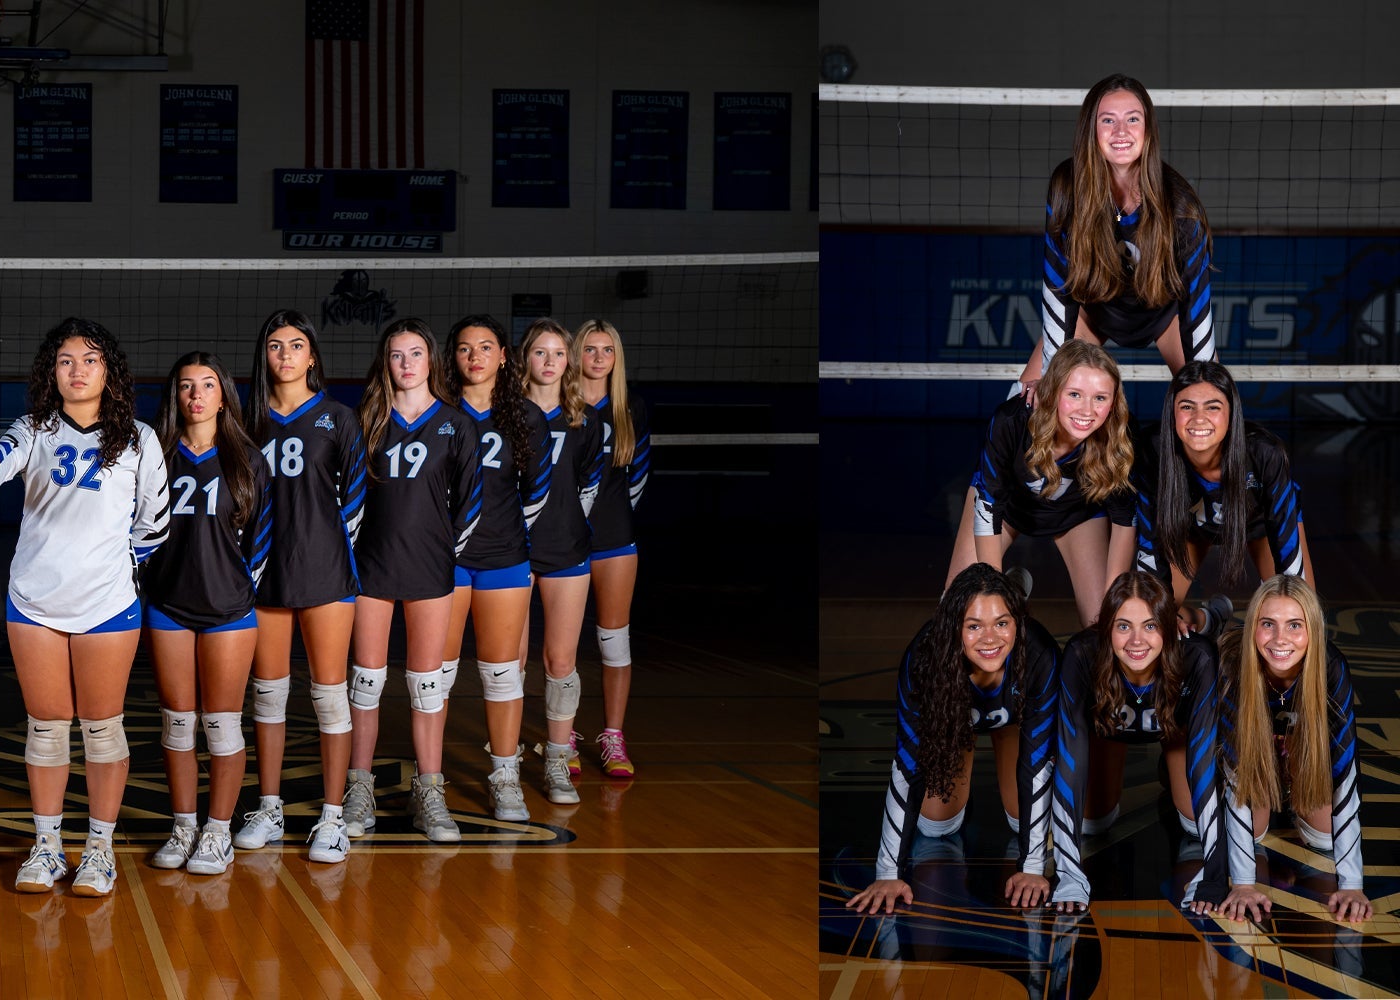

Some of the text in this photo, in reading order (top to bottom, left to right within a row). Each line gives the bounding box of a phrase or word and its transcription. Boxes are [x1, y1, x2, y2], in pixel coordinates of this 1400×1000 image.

[50, 87, 88, 100] GLENN
[165, 89, 234, 102] JOHN GLENN
[497, 94, 565, 107] JOHN GLENN
[618, 95, 646, 107] JOHN
[283, 173, 324, 184] GUEST
[409, 175, 447, 186] HOME
[333, 211, 370, 221] PERIOD
[289, 234, 437, 250] OUR HOUSE
[261, 436, 305, 478] 18
[384, 441, 429, 479] 19
[50, 444, 105, 492] 32
[171, 474, 220, 517] 21
